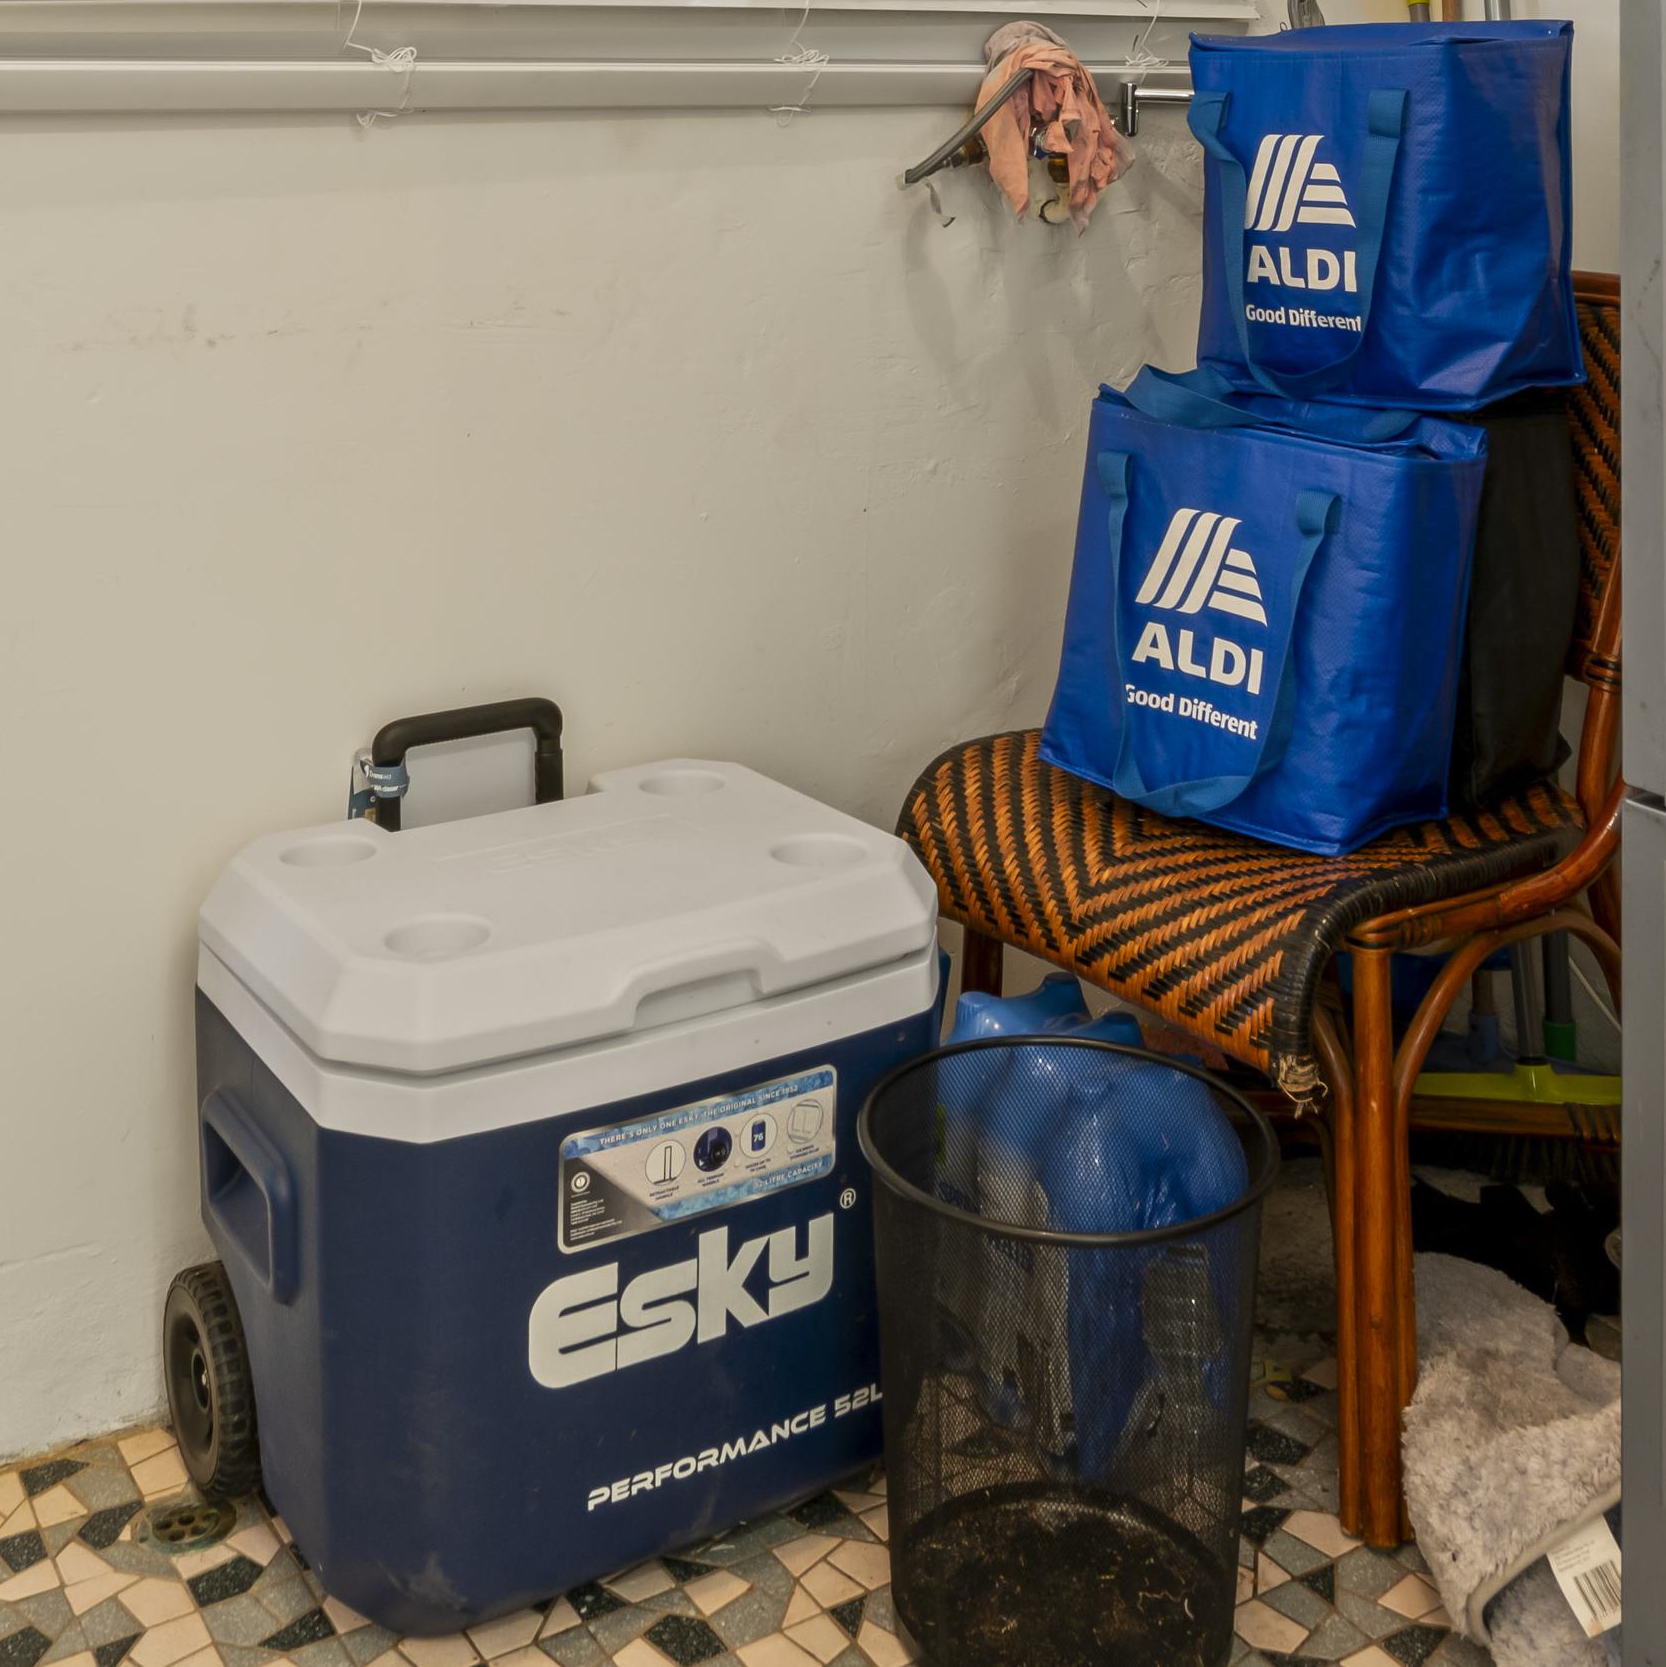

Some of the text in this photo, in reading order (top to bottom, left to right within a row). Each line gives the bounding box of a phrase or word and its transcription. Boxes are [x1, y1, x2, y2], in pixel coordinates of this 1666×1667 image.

[1247, 245, 1357, 292] ALDI
[1246, 304, 1361, 332] Good Different
[1132, 621, 1264, 695] ALDI
[1178, 697, 1258, 740] Different
[636, 1123, 657, 1137] ONLY
[659, 1118, 677, 1130] ONE
[719, 1096, 756, 1113] ORIGINAL
[757, 1090, 780, 1102] SINCE
[752, 1131, 763, 1143] 76
[788, 1160, 822, 1178] CAPACITY
[588, 1383, 883, 1511] PERFORMANCE 52L
